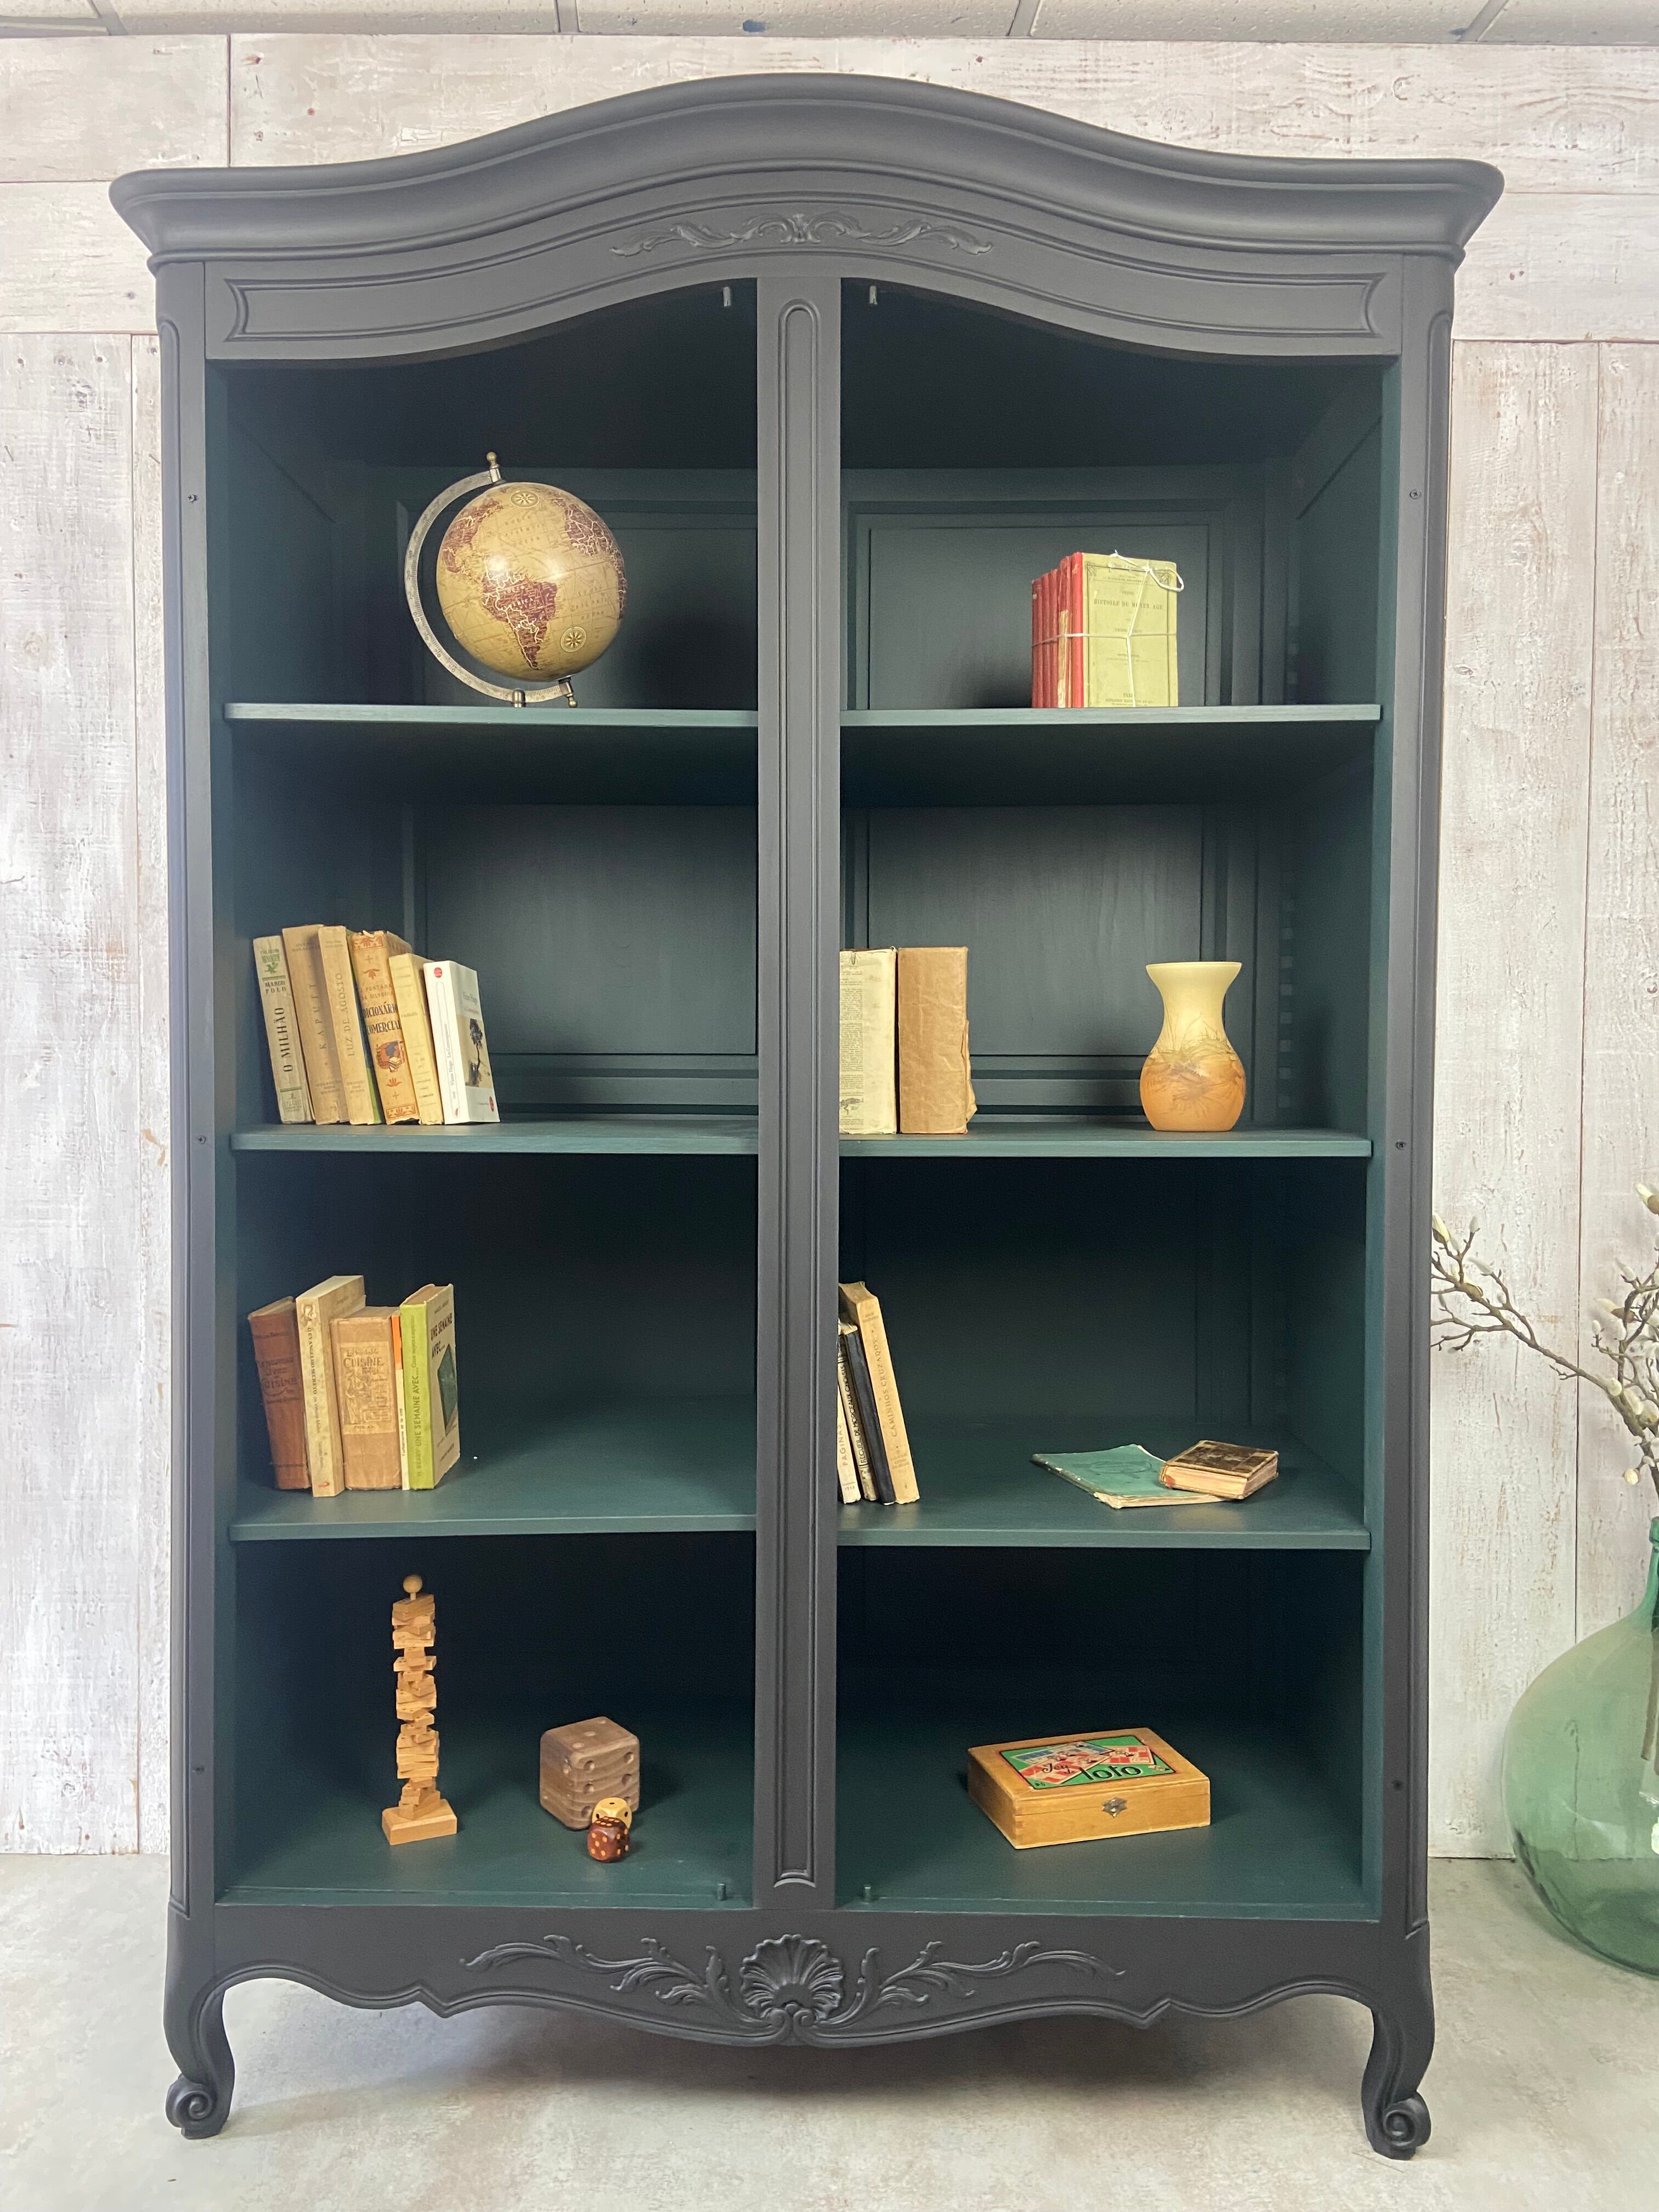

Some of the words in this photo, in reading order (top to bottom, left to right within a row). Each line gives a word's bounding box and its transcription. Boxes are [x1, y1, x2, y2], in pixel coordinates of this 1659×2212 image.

[1094, 599, 1120, 607] HISTOIRE
[336, 973, 348, 1012] AGOSTO
[363, 1002, 398, 1019] DICIONÁRIO
[274, 1007, 291, 1058] MILHÃO
[343, 1019, 351, 1031] DE
[367, 1020, 402, 1035] COMERCIAL
[346, 1036, 356, 1057] LUZ
[438, 1312, 452, 1334] SEMAINE
[343, 1357, 384, 1369] CUISINE
[872, 1339, 887, 1387] CRUZADOS
[413, 1396, 421, 1429] SEMAINE
[848, 1394, 859, 1427] MORCEAUX
[882, 1389, 898, 1437] CAMINHOS
[414, 1431, 422, 1447] UNE
[856, 1438, 866, 1464] RECUEIL
[1079, 1765, 1142, 1781] loto
